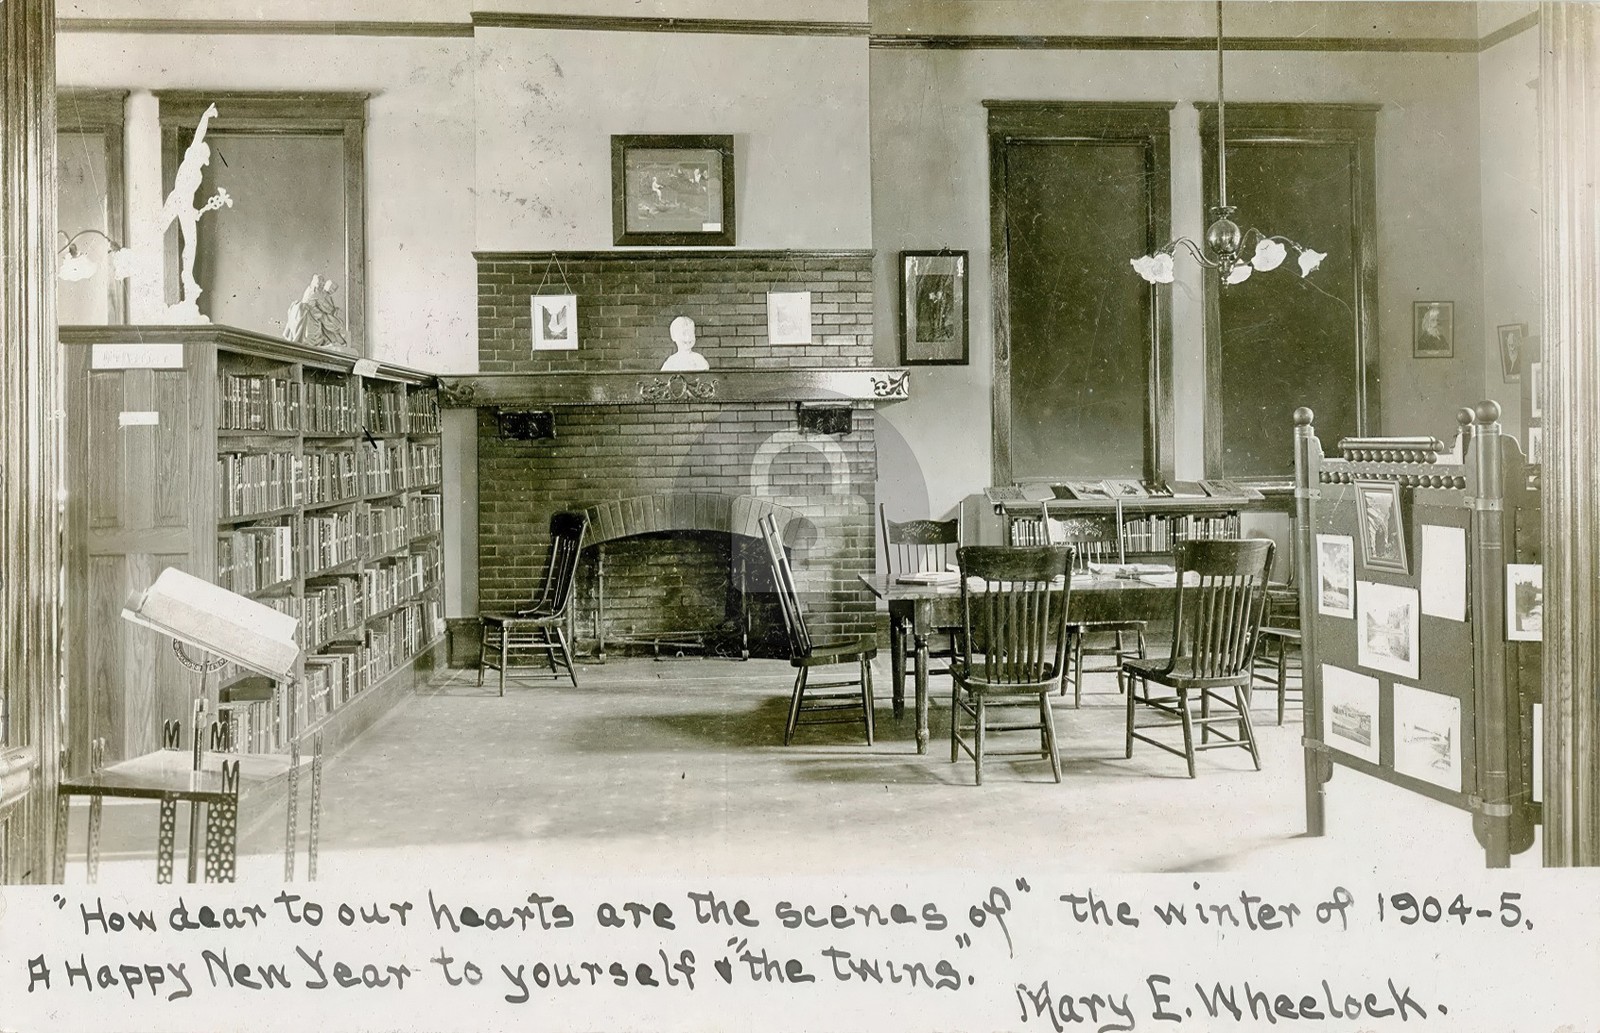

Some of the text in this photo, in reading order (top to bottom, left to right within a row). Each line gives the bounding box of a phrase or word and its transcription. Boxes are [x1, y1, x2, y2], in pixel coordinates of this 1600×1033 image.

[52, 877, 1534, 959] "How dear to our hearts are the scenes of" the winter of 1904-5.
[27, 953, 51, 993] A
[64, 953, 193, 1002] Happy
[201, 946, 292, 990] New
[295, 945, 411, 990] Year
[433, 947, 483, 986] to
[500, 947, 696, 1004] yourself
[727, 936, 816, 985] "the
[1015, 974, 1448, 1033] Mary E. Wheelock.
